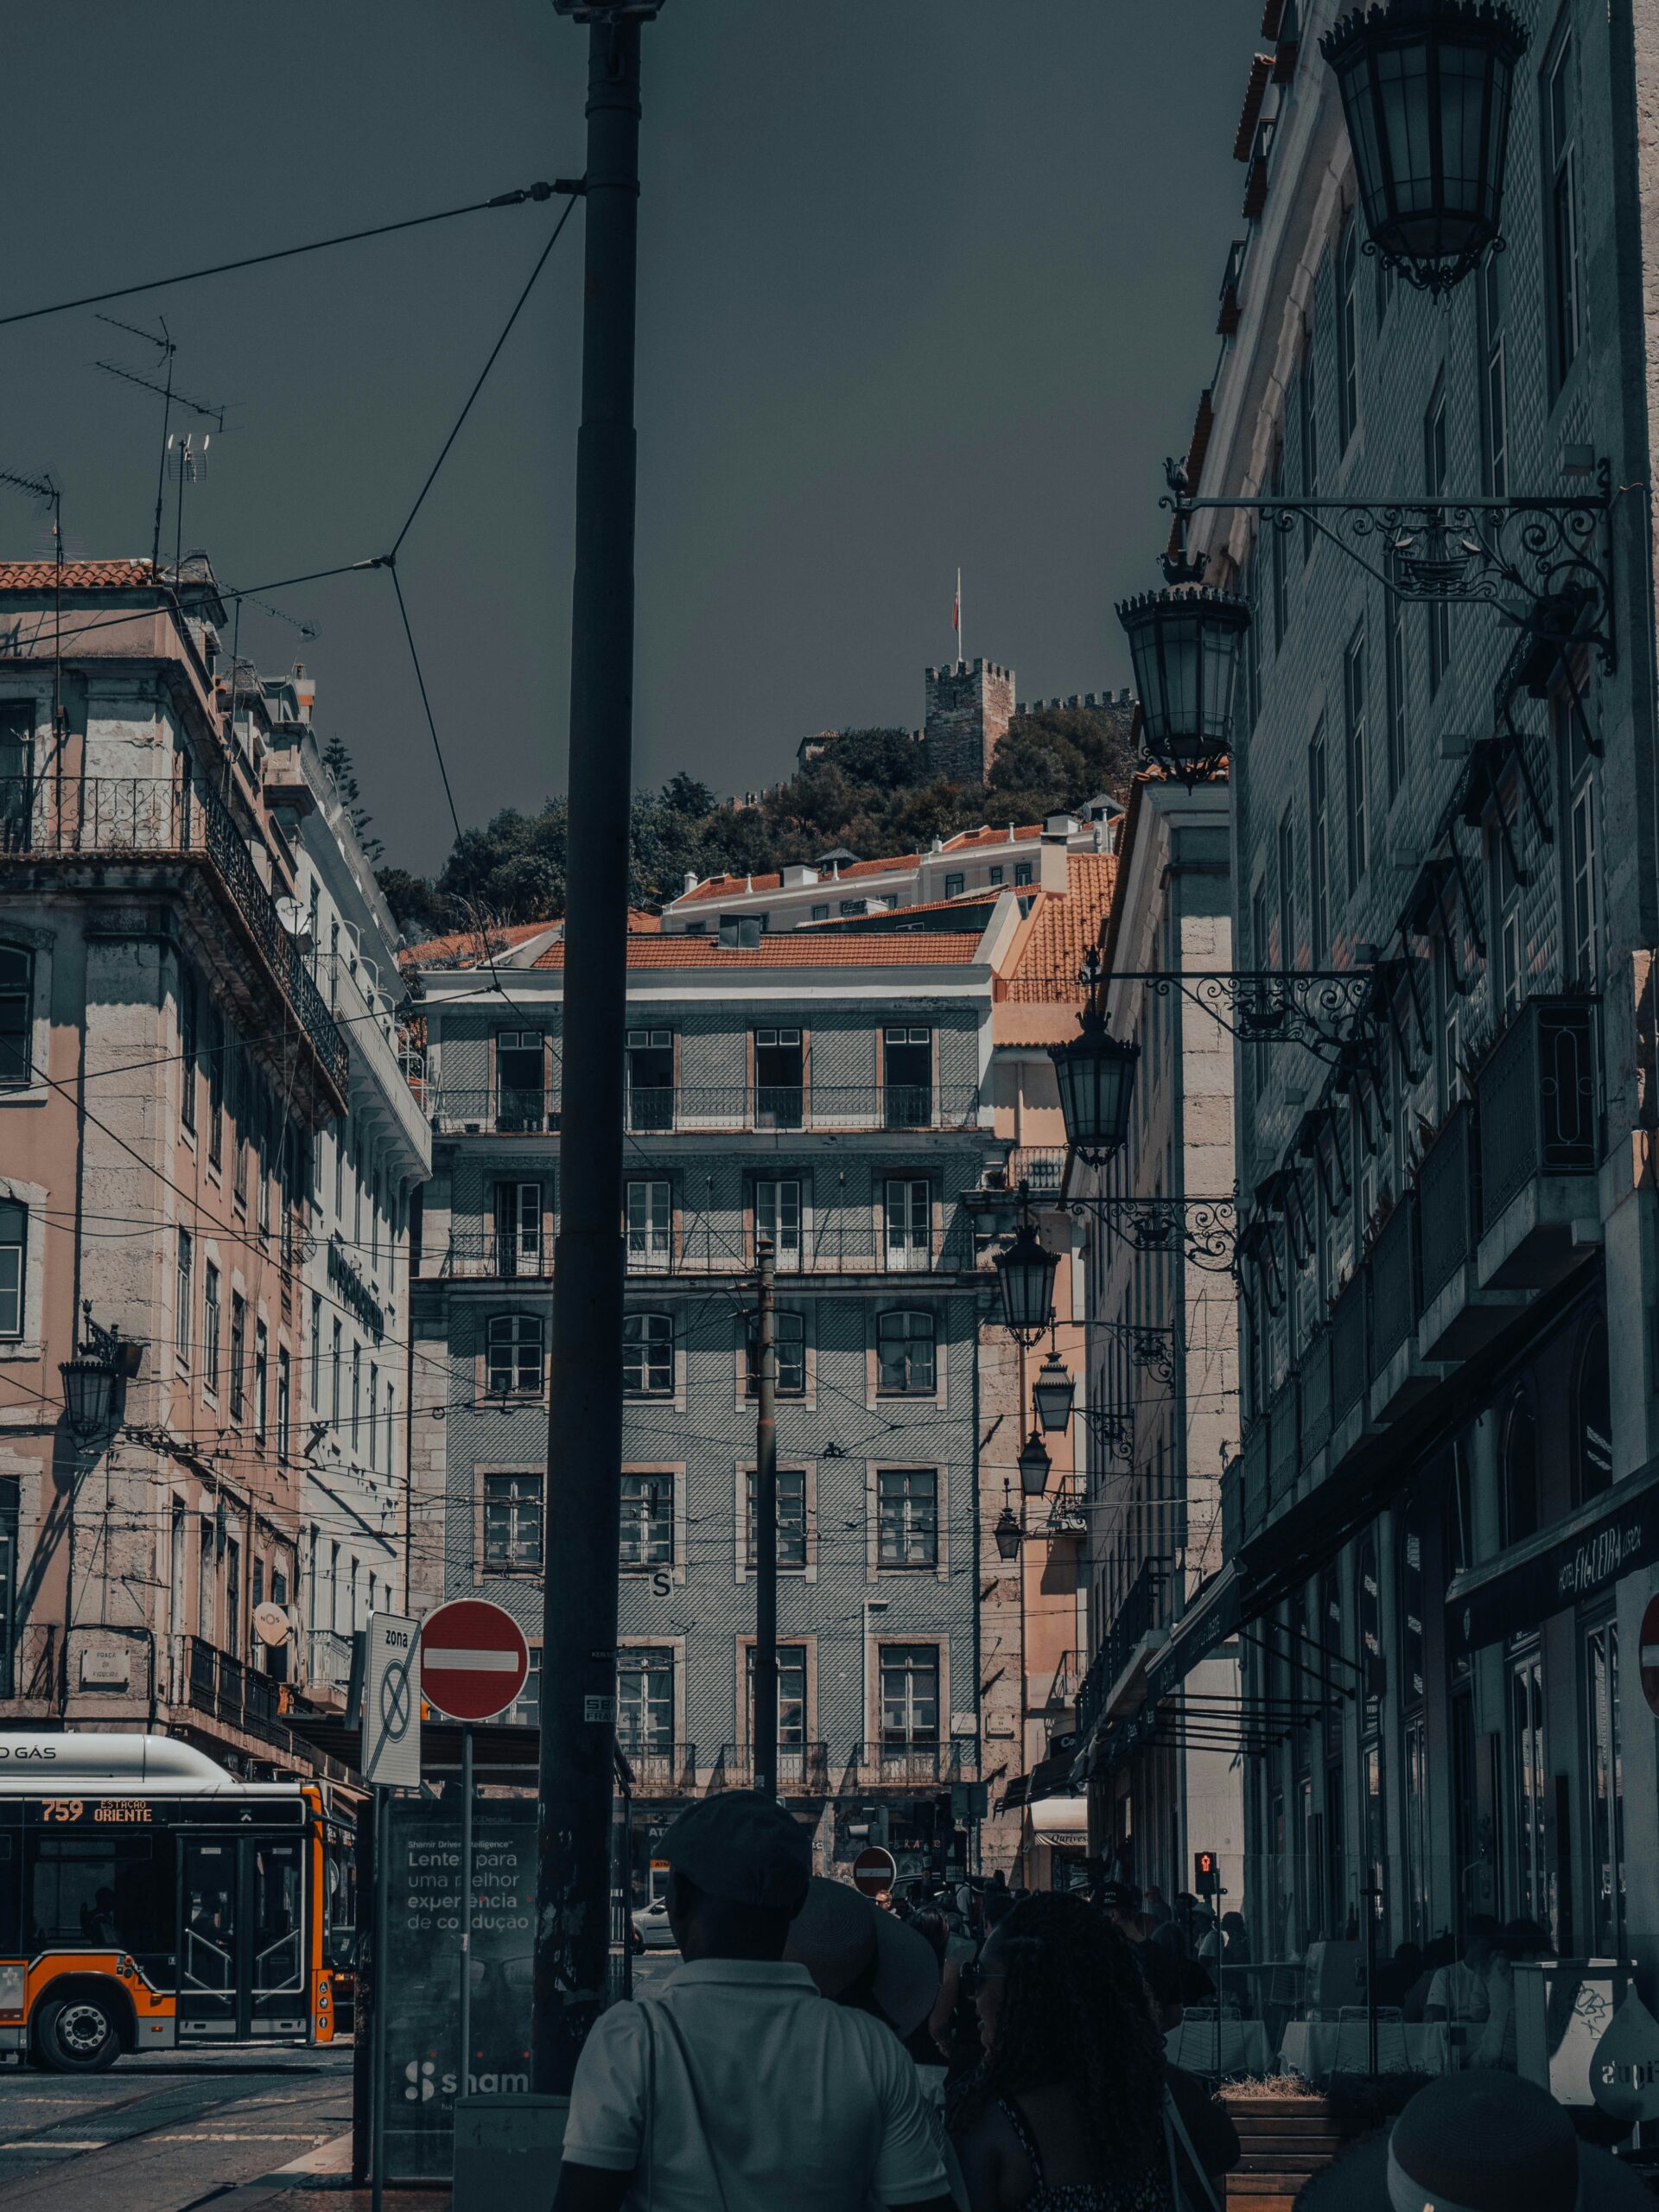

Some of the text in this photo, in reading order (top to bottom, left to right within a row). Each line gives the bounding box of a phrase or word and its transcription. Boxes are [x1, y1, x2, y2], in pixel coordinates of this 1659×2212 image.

[1573, 1523, 1621, 1593] FIGUEIRA
[652, 1573, 671, 1597] S
[260, 1612, 280, 1624] NOS
[385, 1629, 408, 1648] zona
[15, 1745, 56, 1758] GÁS
[41, 1800, 84, 1822] 759
[93, 1808, 153, 1822] ORIENTE
[408, 1840, 435, 1849] Shamir
[438, 1840, 461, 1849] Driver
[409, 1853, 518, 1870] Lente para
[408, 1875, 448, 1887] uma
[408, 1892, 518, 1911] experência
[408, 1914, 529, 1932] de codução
